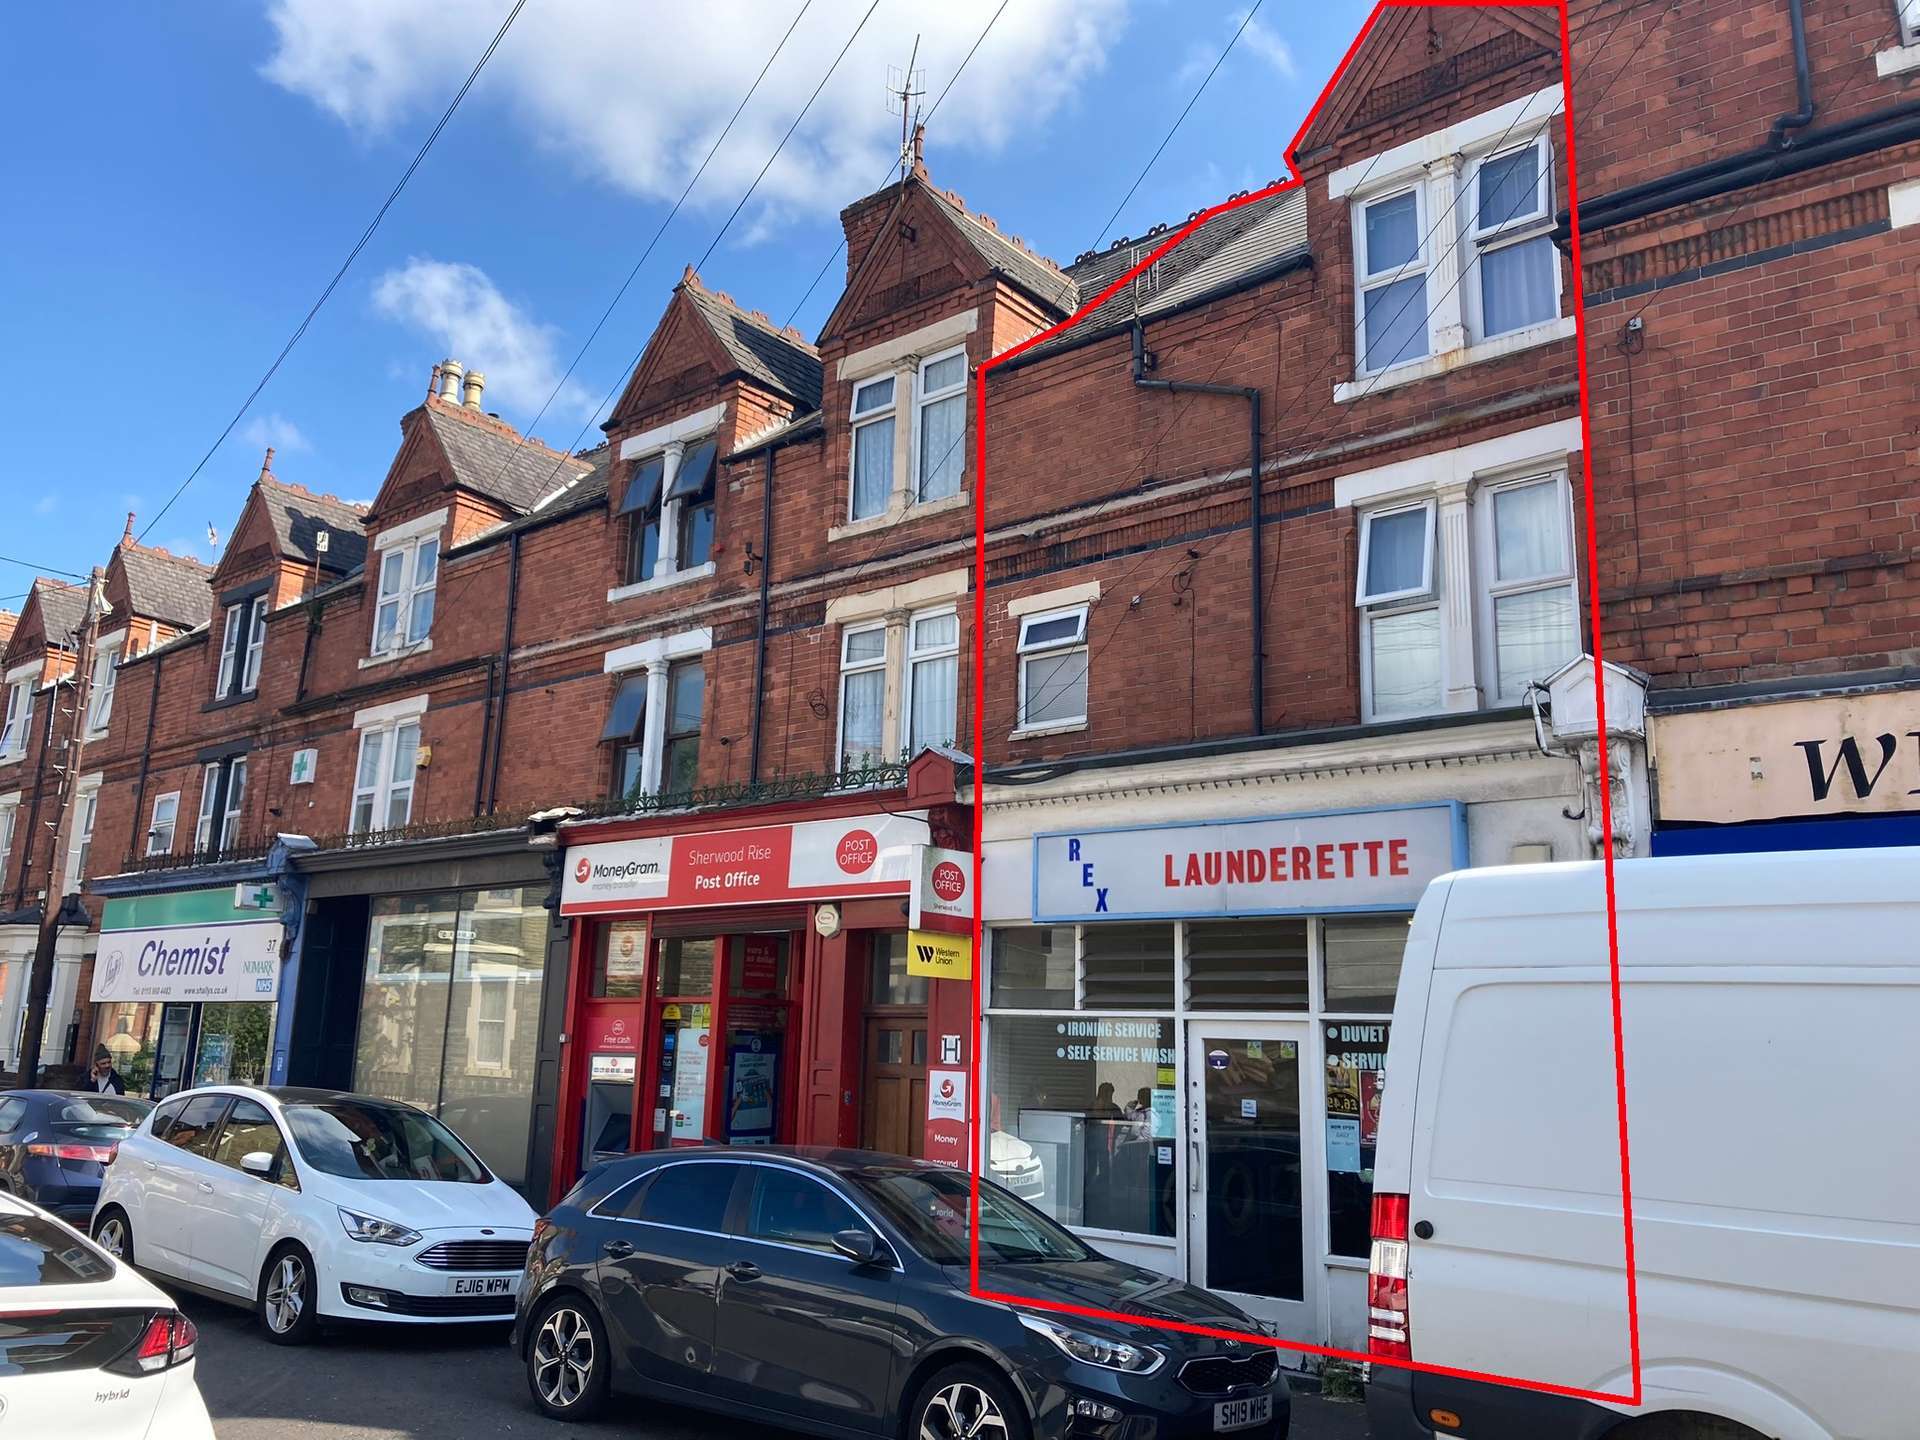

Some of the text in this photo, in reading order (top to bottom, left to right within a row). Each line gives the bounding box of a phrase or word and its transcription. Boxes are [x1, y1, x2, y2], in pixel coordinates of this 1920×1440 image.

[845, 839, 871, 851] POST
[689, 845, 772, 865] Sherwood Rise
[839, 852, 873, 866] OFFICE
[593, 861, 659, 880] MoneyGram
[1164, 838, 1410, 888] LAUNDERETTE
[695, 871, 760, 889] Post Office
[939, 869, 960, 880] POST
[1069, 838, 1109, 912] REX
[934, 880, 962, 893] OFFICE
[266, 939, 277, 952] 37
[935, 948, 960, 958] Western
[137, 937, 231, 977] Chemist
[935, 956, 953, 965] Union
[242, 960, 274, 975] NUMARK
[257, 979, 273, 992] NHS
[1067, 1021, 1162, 1039] IRONING SERVICE
[1340, 1025, 1385, 1042] DUVET
[1067, 1045, 1093, 1061] SELF
[1093, 1046, 1138, 1062] SERVICE
[934, 1134, 958, 1146] Money
[455, 1279, 484, 1293] EJ16
[94, 1389, 130, 1404] hybrid
[1221, 1396, 1268, 1425] SH19 WHE
